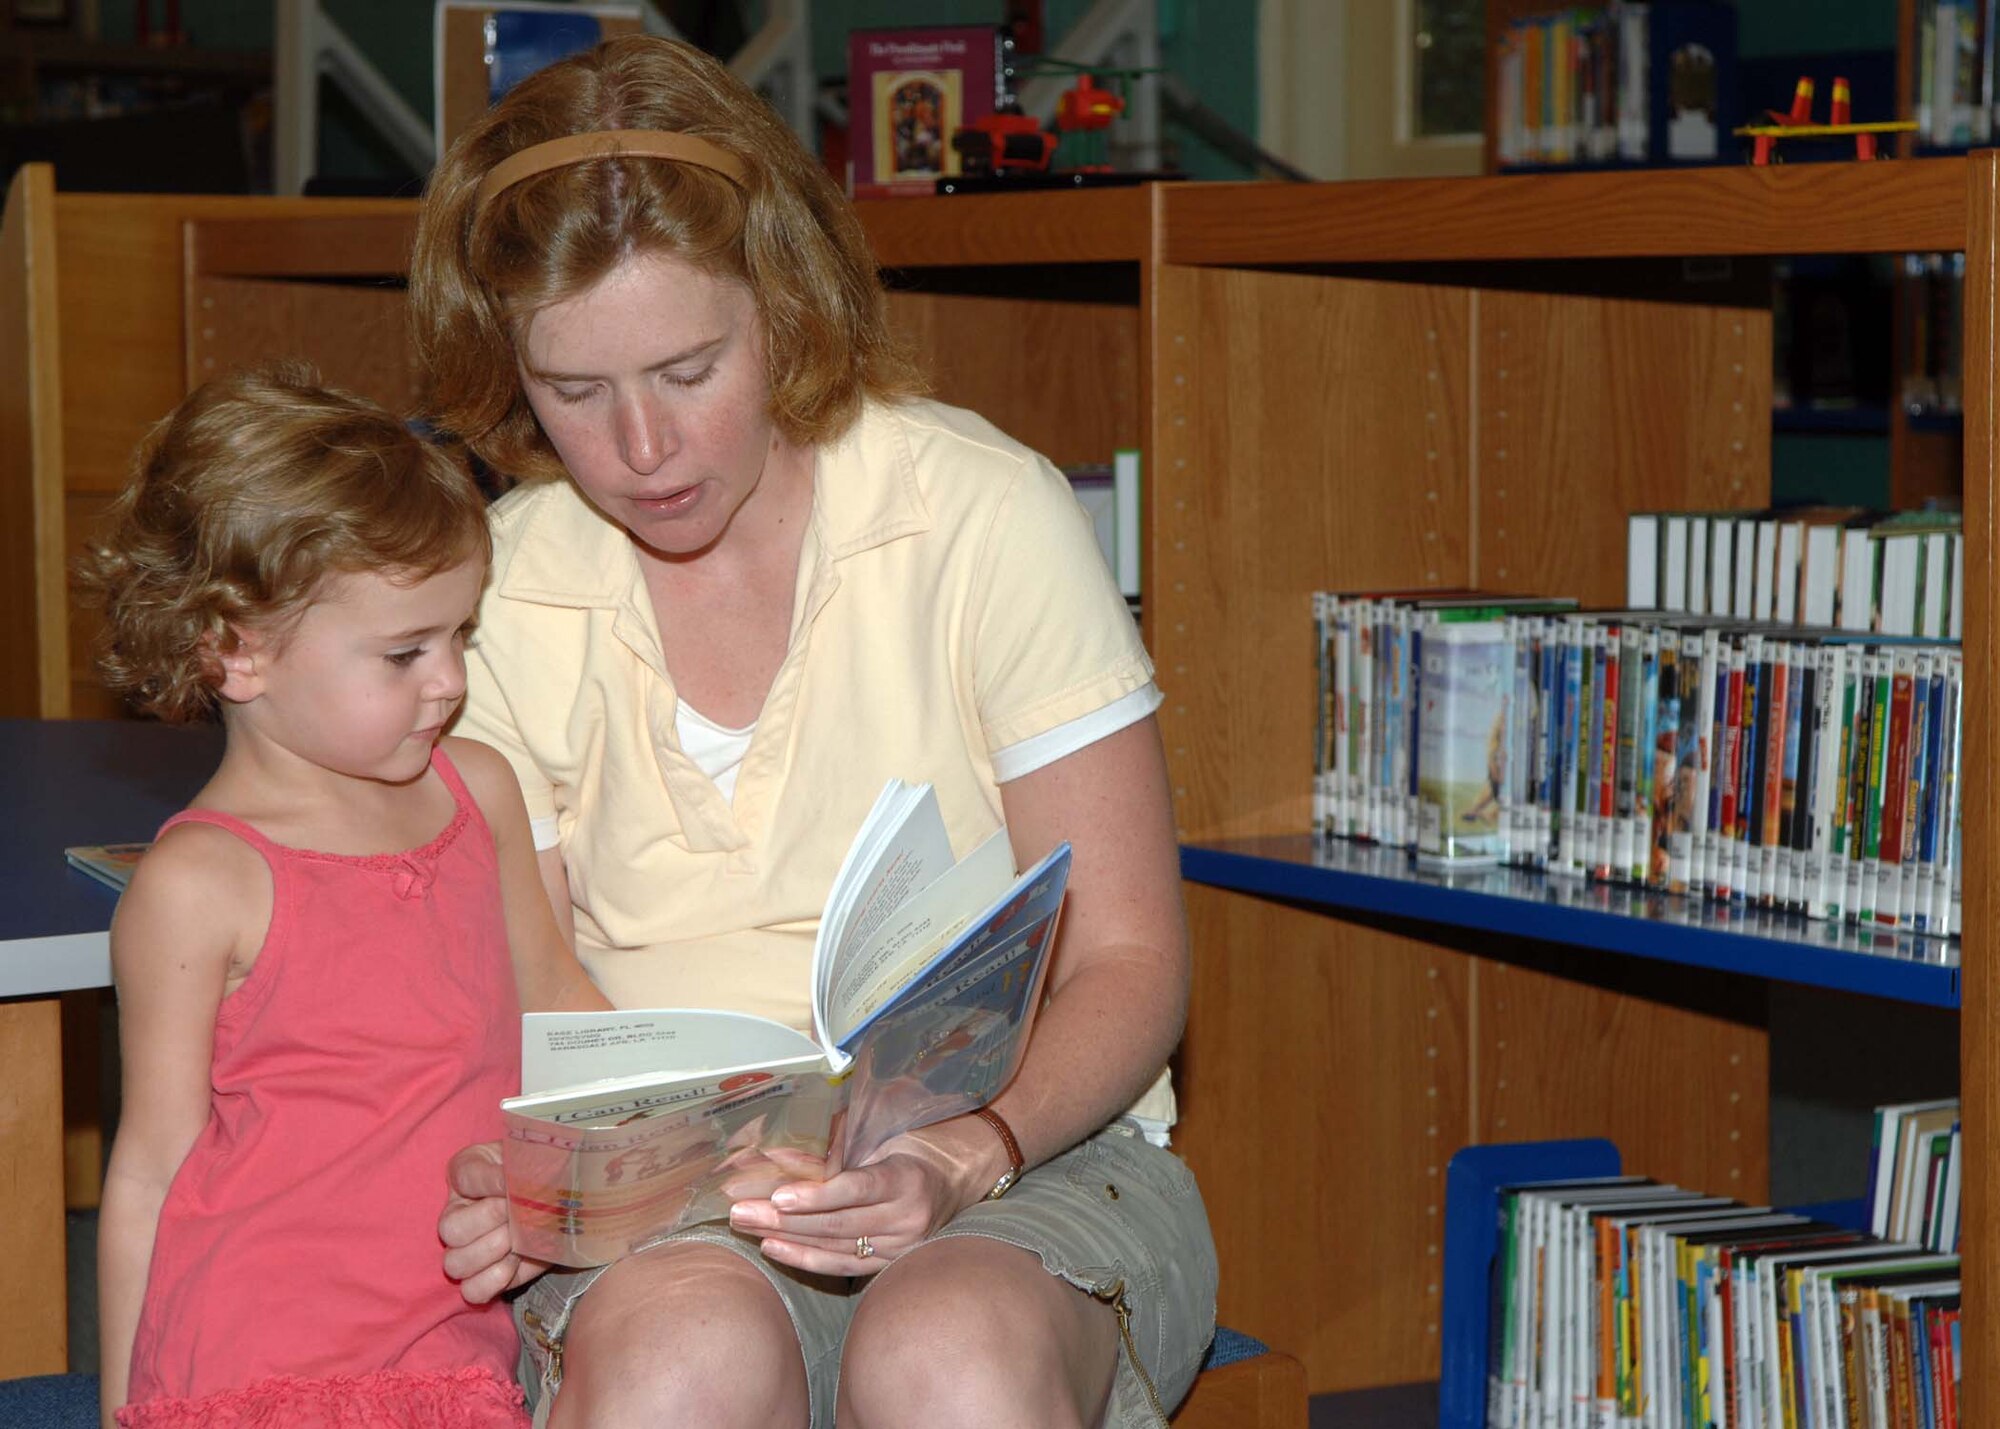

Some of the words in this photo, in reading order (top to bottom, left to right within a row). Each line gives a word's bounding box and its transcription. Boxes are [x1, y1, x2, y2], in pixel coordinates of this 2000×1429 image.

[956, 949, 1016, 993] Read!
[571, 1106, 624, 1120] Can
[634, 1087, 706, 1108] Read!
